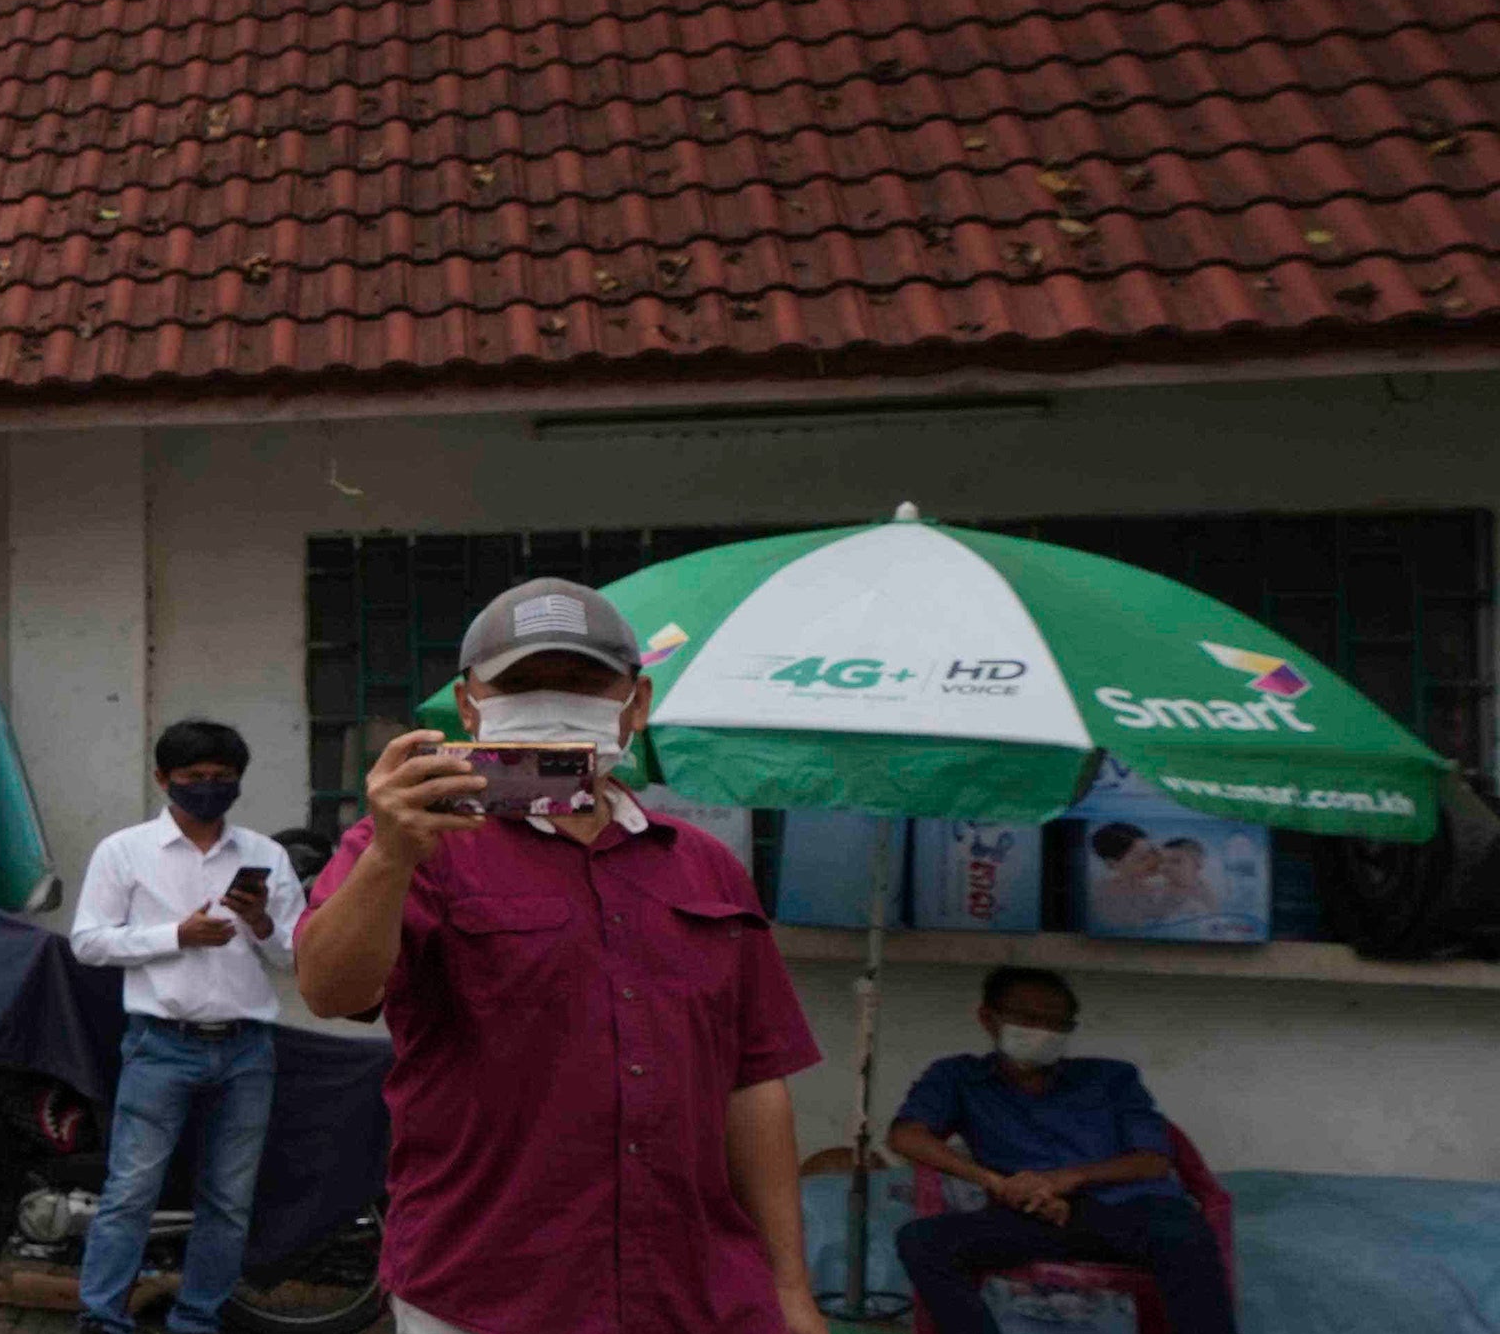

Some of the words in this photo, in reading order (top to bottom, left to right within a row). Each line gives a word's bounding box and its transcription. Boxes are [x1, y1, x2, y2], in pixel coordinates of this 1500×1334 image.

[770, 657, 916, 688] 4G+
[946, 660, 1029, 681] HD
[941, 684, 1021, 696] VOICE
[1095, 687, 1316, 732] Smart
